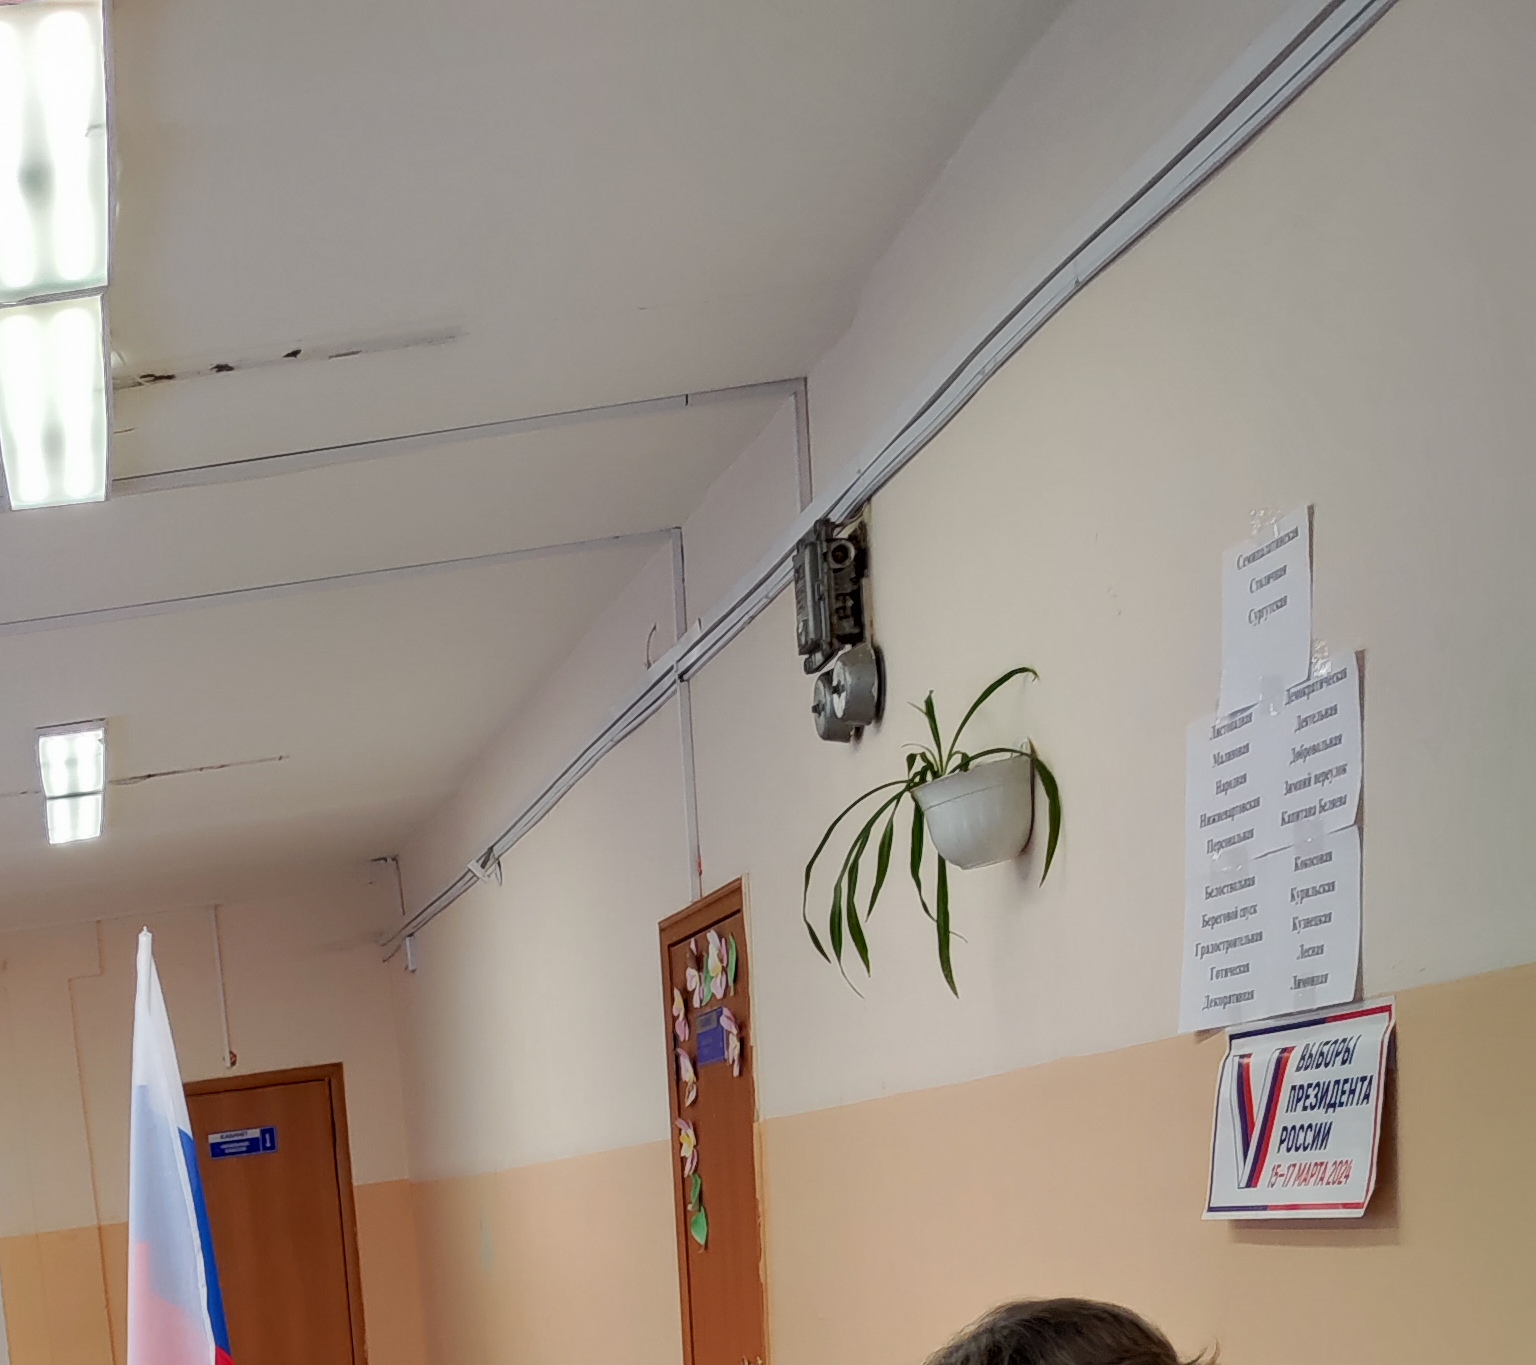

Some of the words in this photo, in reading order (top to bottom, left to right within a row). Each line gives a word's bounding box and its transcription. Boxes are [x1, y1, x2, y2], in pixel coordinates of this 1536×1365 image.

[1295, 1035, 1362, 1073] ВЫБОРЫ
[1285, 1074, 1374, 1114] ПРЕЗИДЕНТА
[1277, 1121, 1333, 1154] РОССИИ
[1294, 1161, 1326, 1187] МАРТА
[1326, 1159, 1353, 1186] 2024
